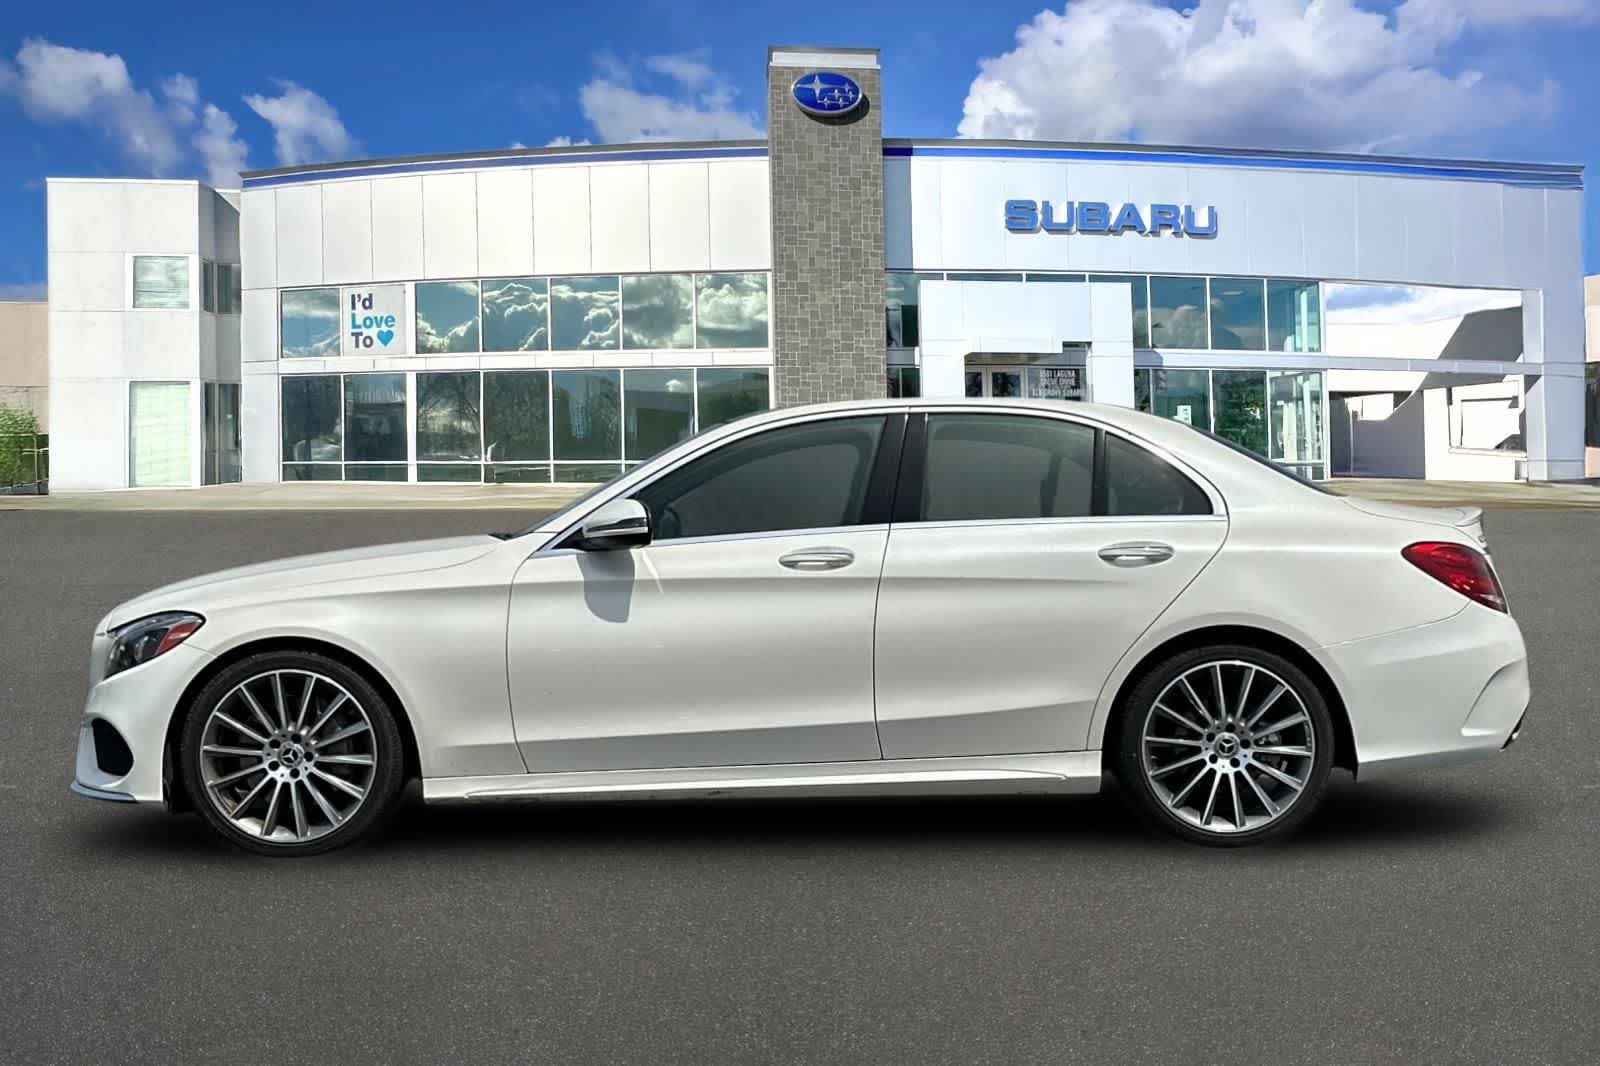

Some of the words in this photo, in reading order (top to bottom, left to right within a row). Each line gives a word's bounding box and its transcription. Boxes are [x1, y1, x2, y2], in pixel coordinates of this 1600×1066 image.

[1005, 200, 1217, 238] SUBARU
[351, 293, 373, 310] I'd
[351, 312, 396, 329] Love
[351, 331, 374, 348] To
